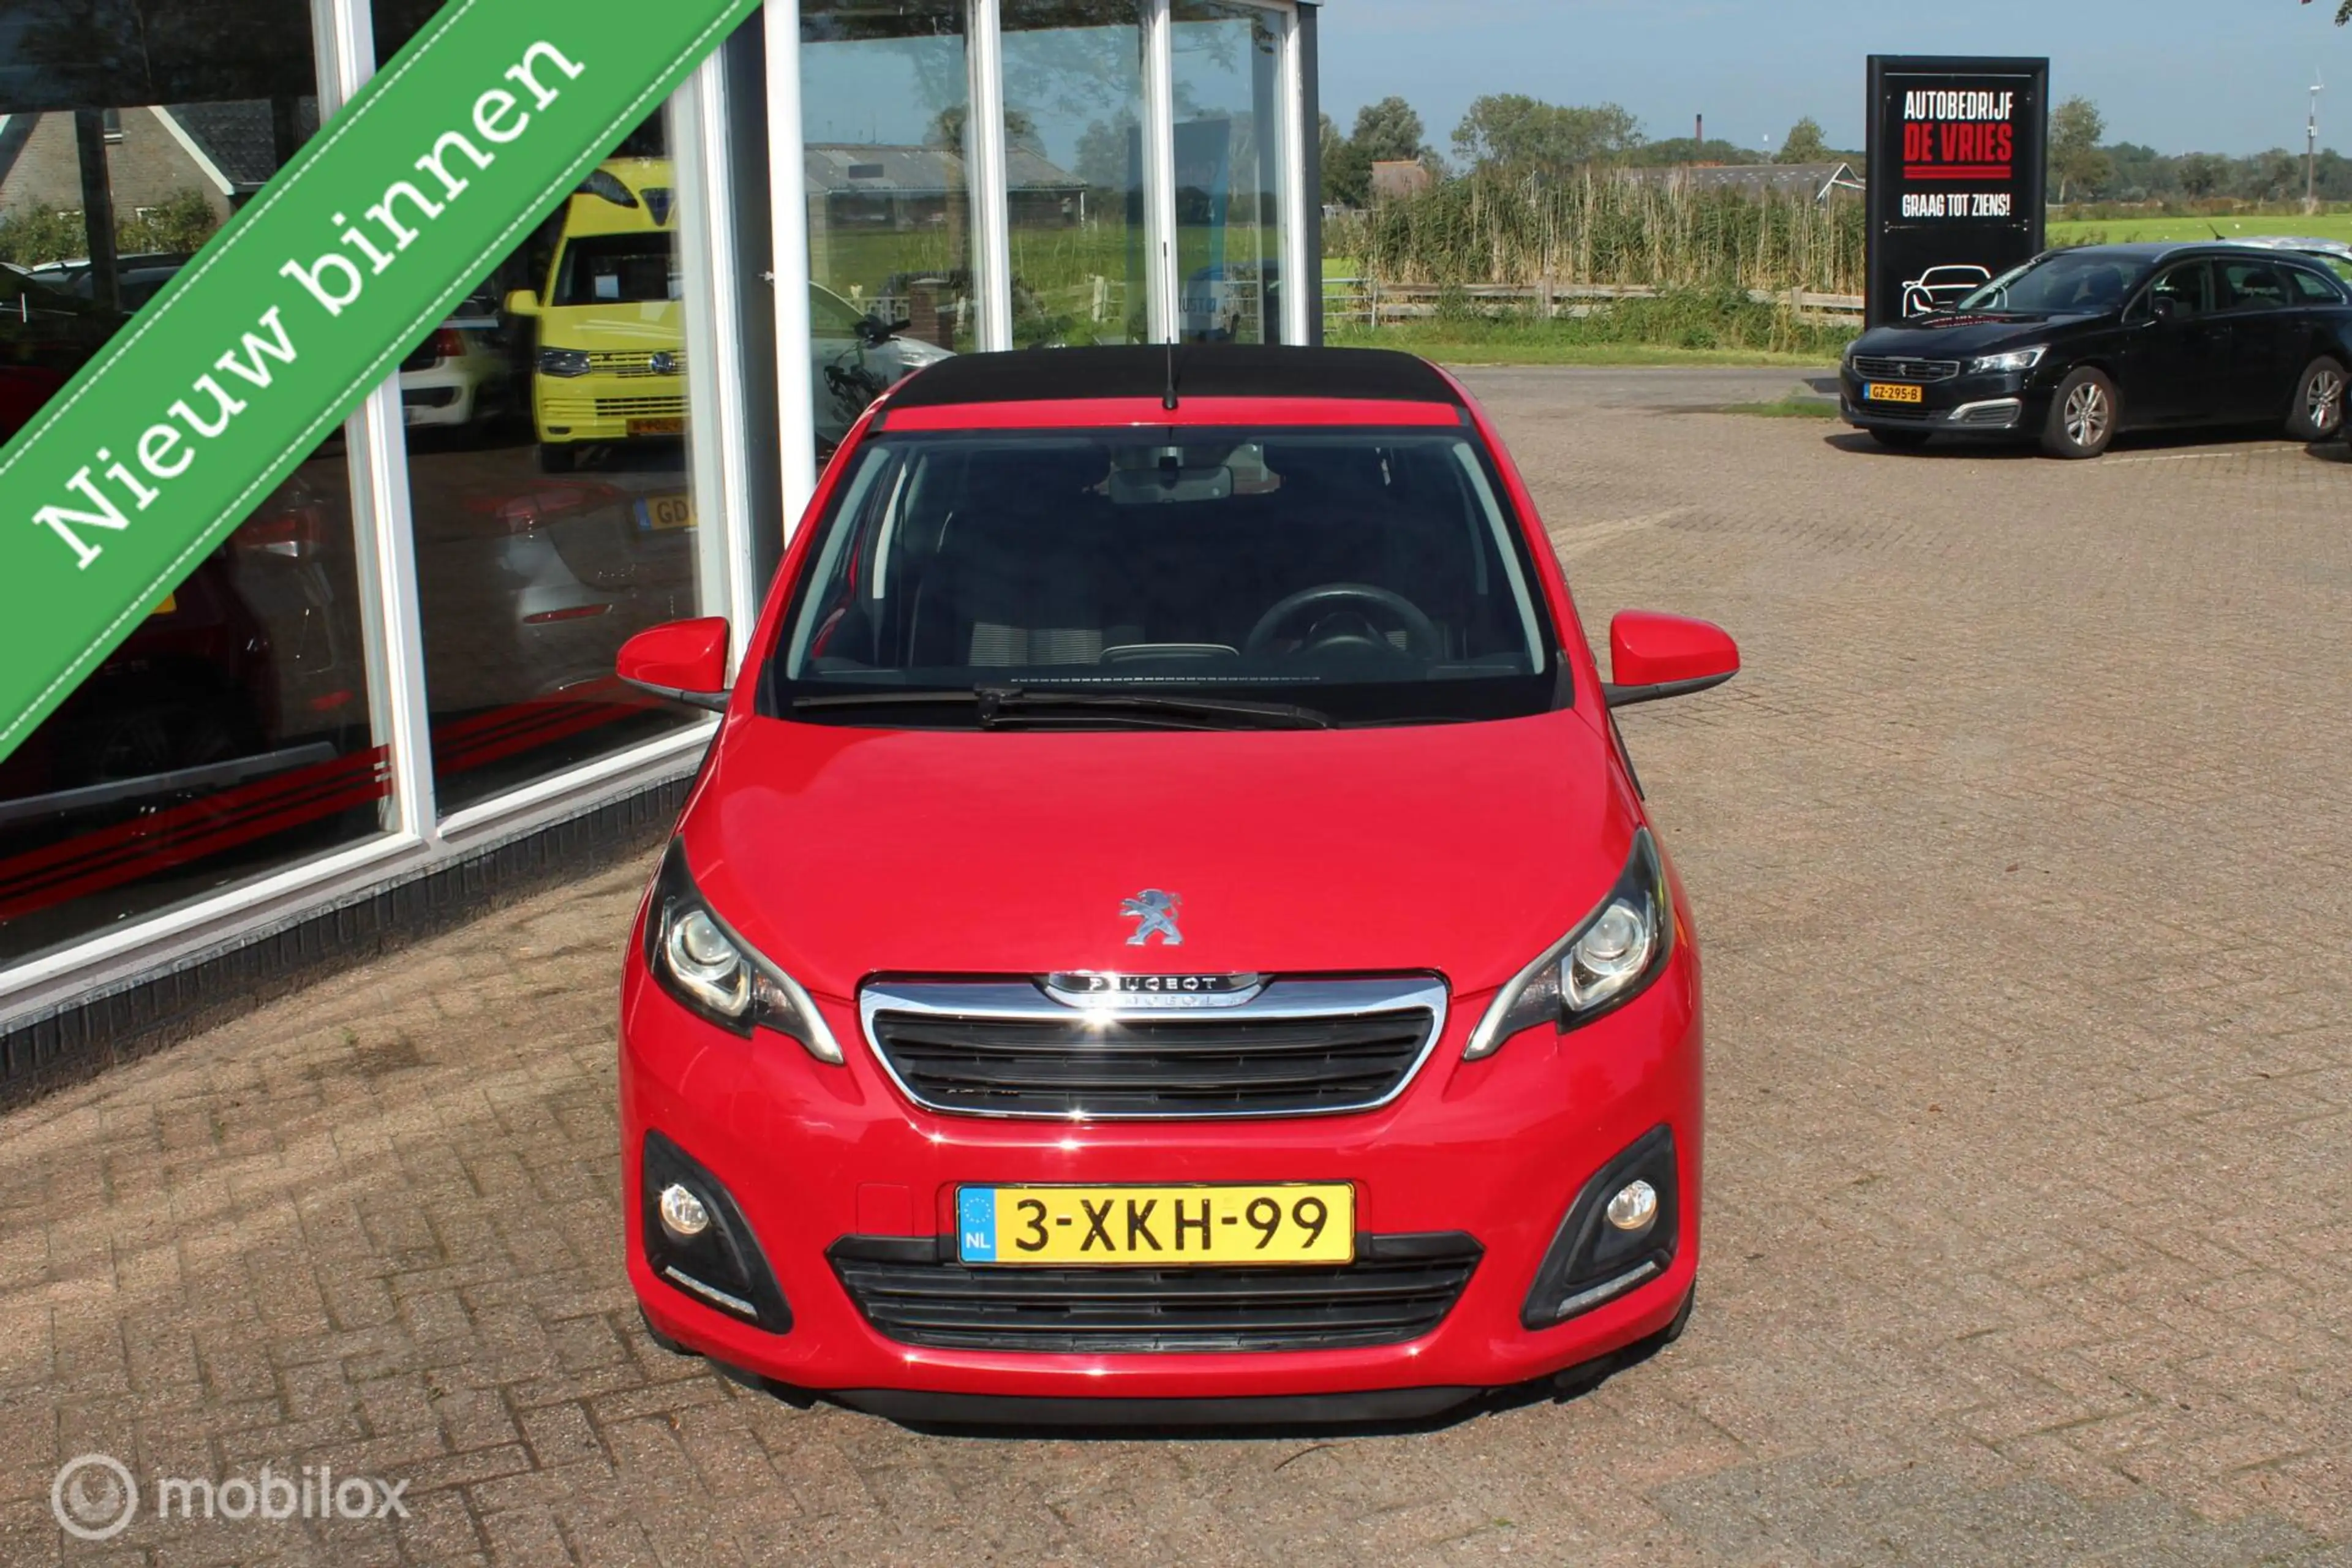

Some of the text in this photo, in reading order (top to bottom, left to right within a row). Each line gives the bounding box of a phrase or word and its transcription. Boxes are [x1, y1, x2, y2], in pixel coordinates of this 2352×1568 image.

[1904, 91, 2014, 120] AUTOBEDRIJF
[1904, 124, 2013, 162] DE VRIES
[1902, 194, 2011, 217] GRAAG TOT ZIENS!
[1872, 386, 1918, 399] GZ-295-B
[657, 500, 697, 524] GD
[1088, 977, 1216, 991] PUGEOT
[1015, 1196, 1329, 1252] 3-XKH-99
[965, 1232, 991, 1249] NL
